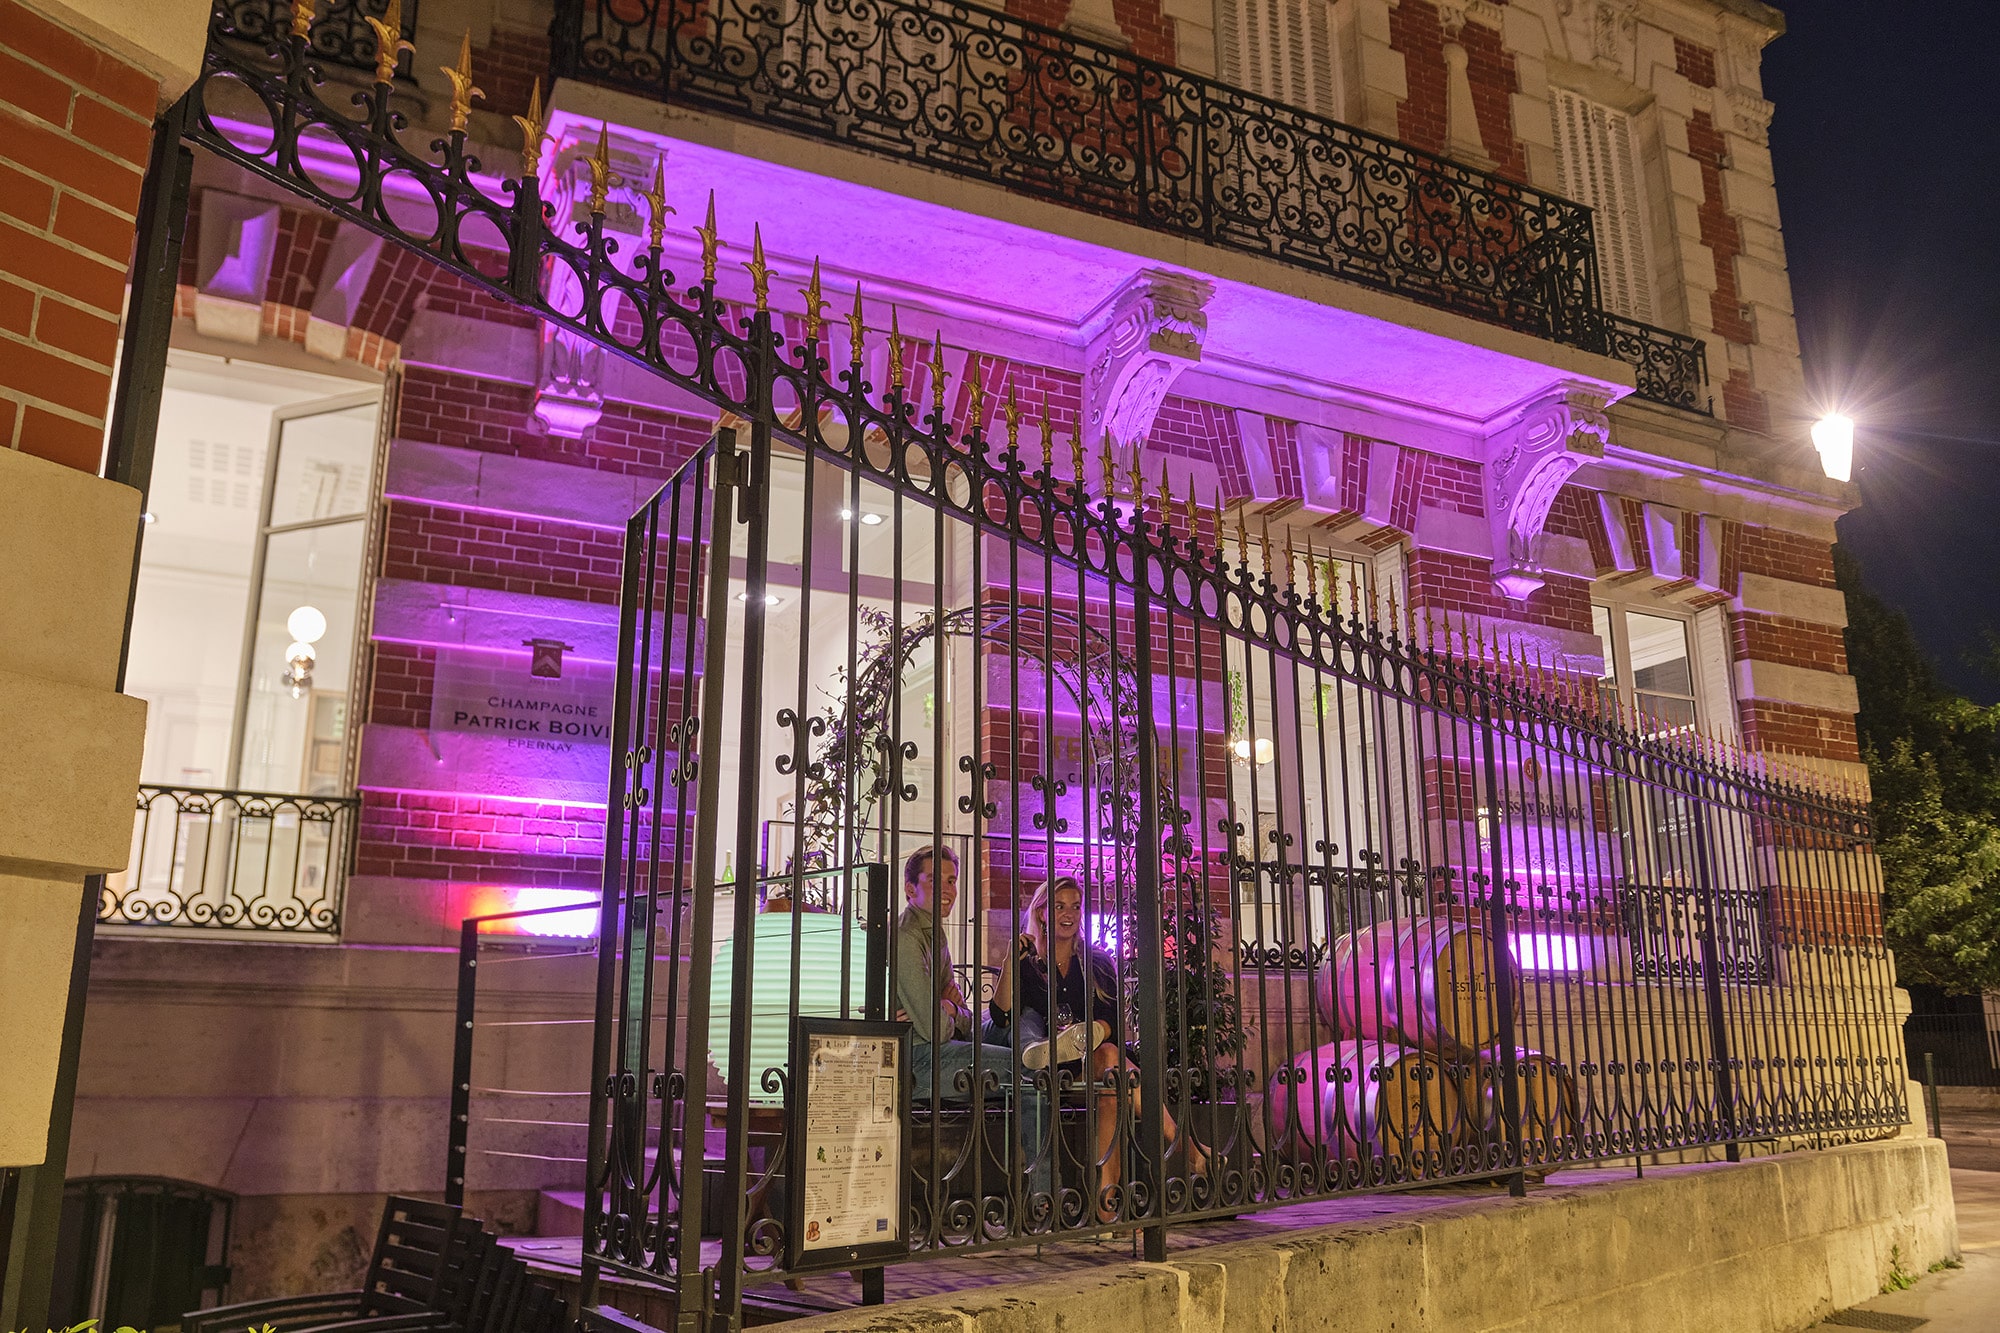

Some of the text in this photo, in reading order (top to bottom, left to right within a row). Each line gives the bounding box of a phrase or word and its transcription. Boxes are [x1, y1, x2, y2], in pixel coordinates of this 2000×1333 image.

[487, 696, 599, 718] CHAMPAGNE
[453, 711, 613, 739] PATRICK BOIVI
[507, 738, 573, 753] EPERNAY
[833, 1146, 842, 1154] Les
